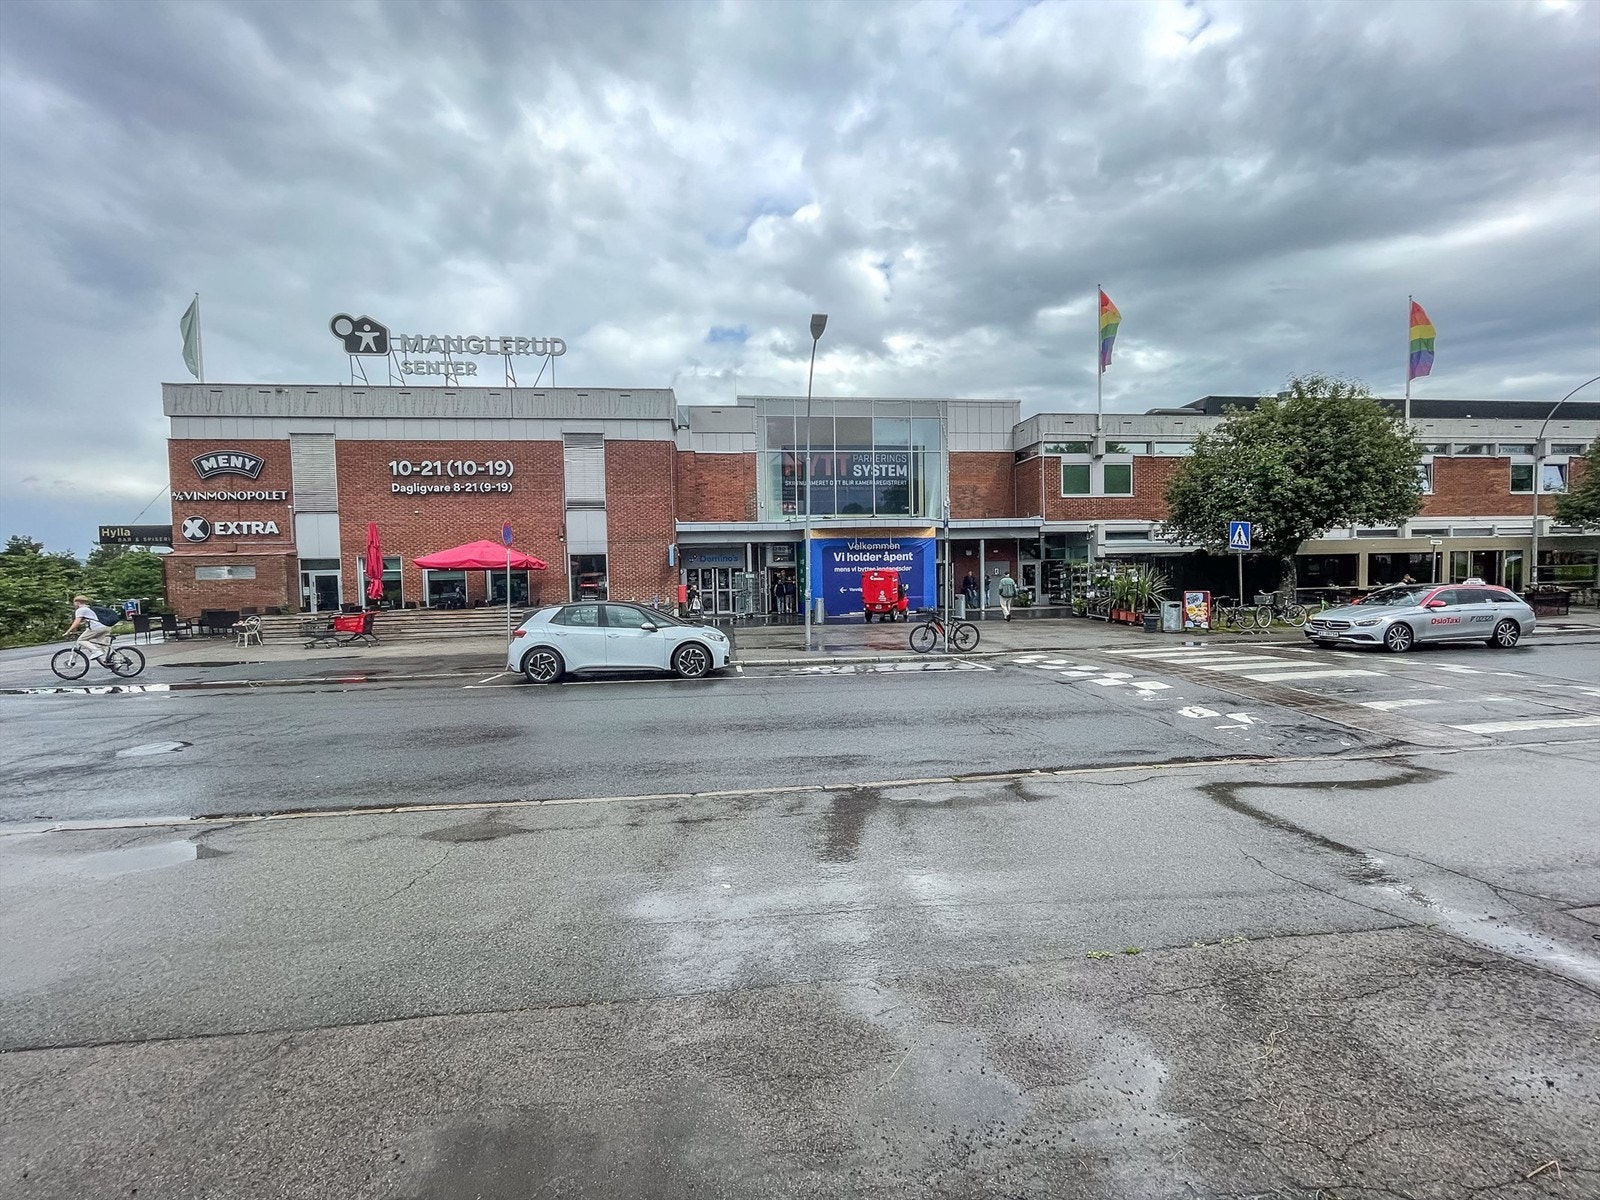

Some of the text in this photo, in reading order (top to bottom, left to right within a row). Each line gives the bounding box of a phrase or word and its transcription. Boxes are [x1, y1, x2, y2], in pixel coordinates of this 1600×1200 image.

[400, 334, 567, 356] MANGLERUD
[400, 359, 478, 376] SENTER
[200, 456, 256, 471] MENY
[389, 459, 514, 477] 10-21 (10-19)
[853, 464, 907, 477] SYSTEM
[184, 490, 287, 500] VINMONOPOLET
[391, 482, 513, 495] Dagligvare 8-21 (9-19)
[101, 527, 131, 538] Hylla
[214, 521, 279, 535] EXTRA
[847, 542, 900, 550] Velkommen
[833, 551, 913, 563] Vi holder åpent
[1431, 617, 1461, 625] OsloTaxi
